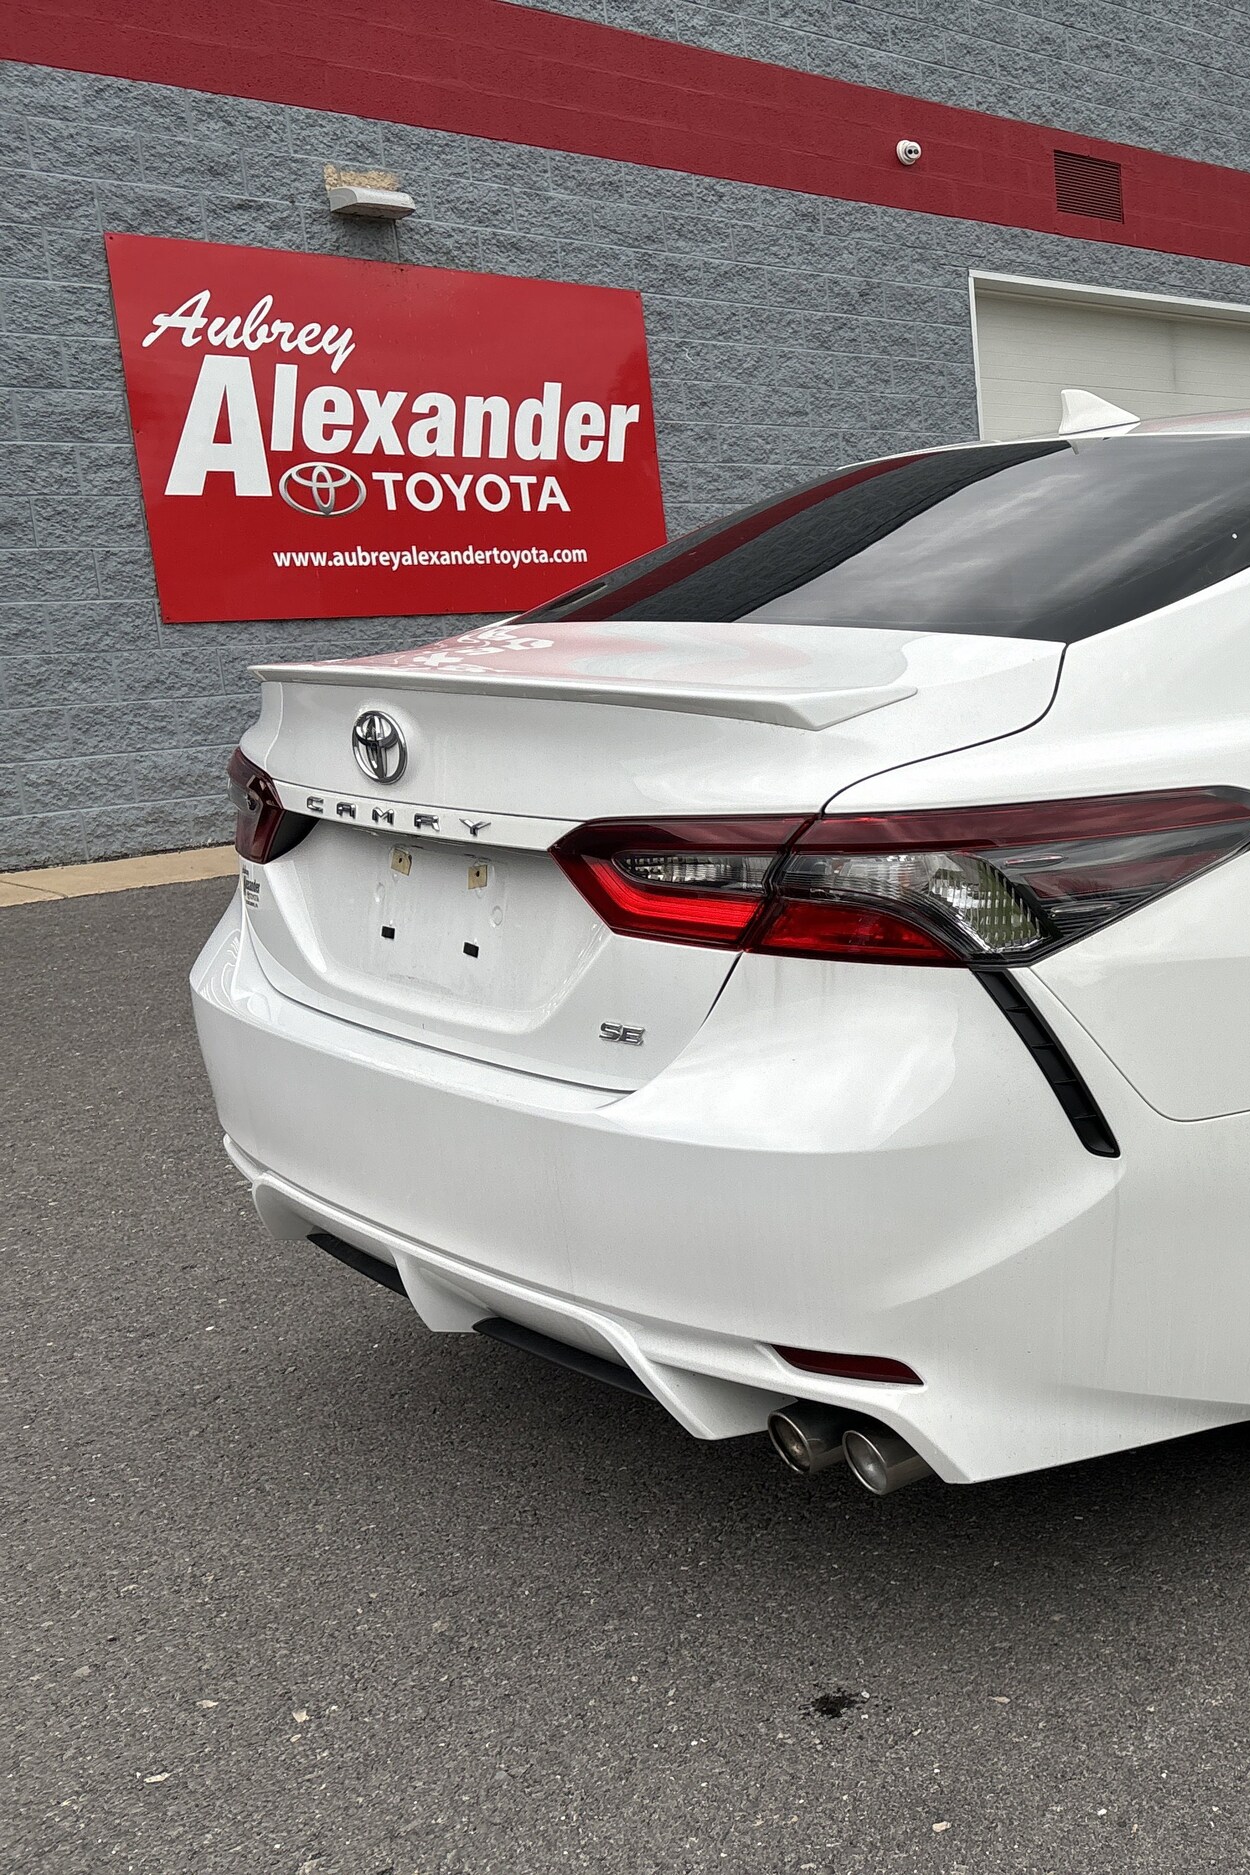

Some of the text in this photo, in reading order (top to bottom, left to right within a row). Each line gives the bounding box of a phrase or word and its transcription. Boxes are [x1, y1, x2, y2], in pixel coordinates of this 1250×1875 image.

[141, 289, 356, 374] Aubrey
[164, 354, 640, 497] Alexander
[372, 471, 572, 512] TOYOTA
[273, 545, 588, 572] www.aubreyalexandertoyota.com
[306, 796, 491, 837] CAMRY
[599, 1022, 645, 1047] SE
